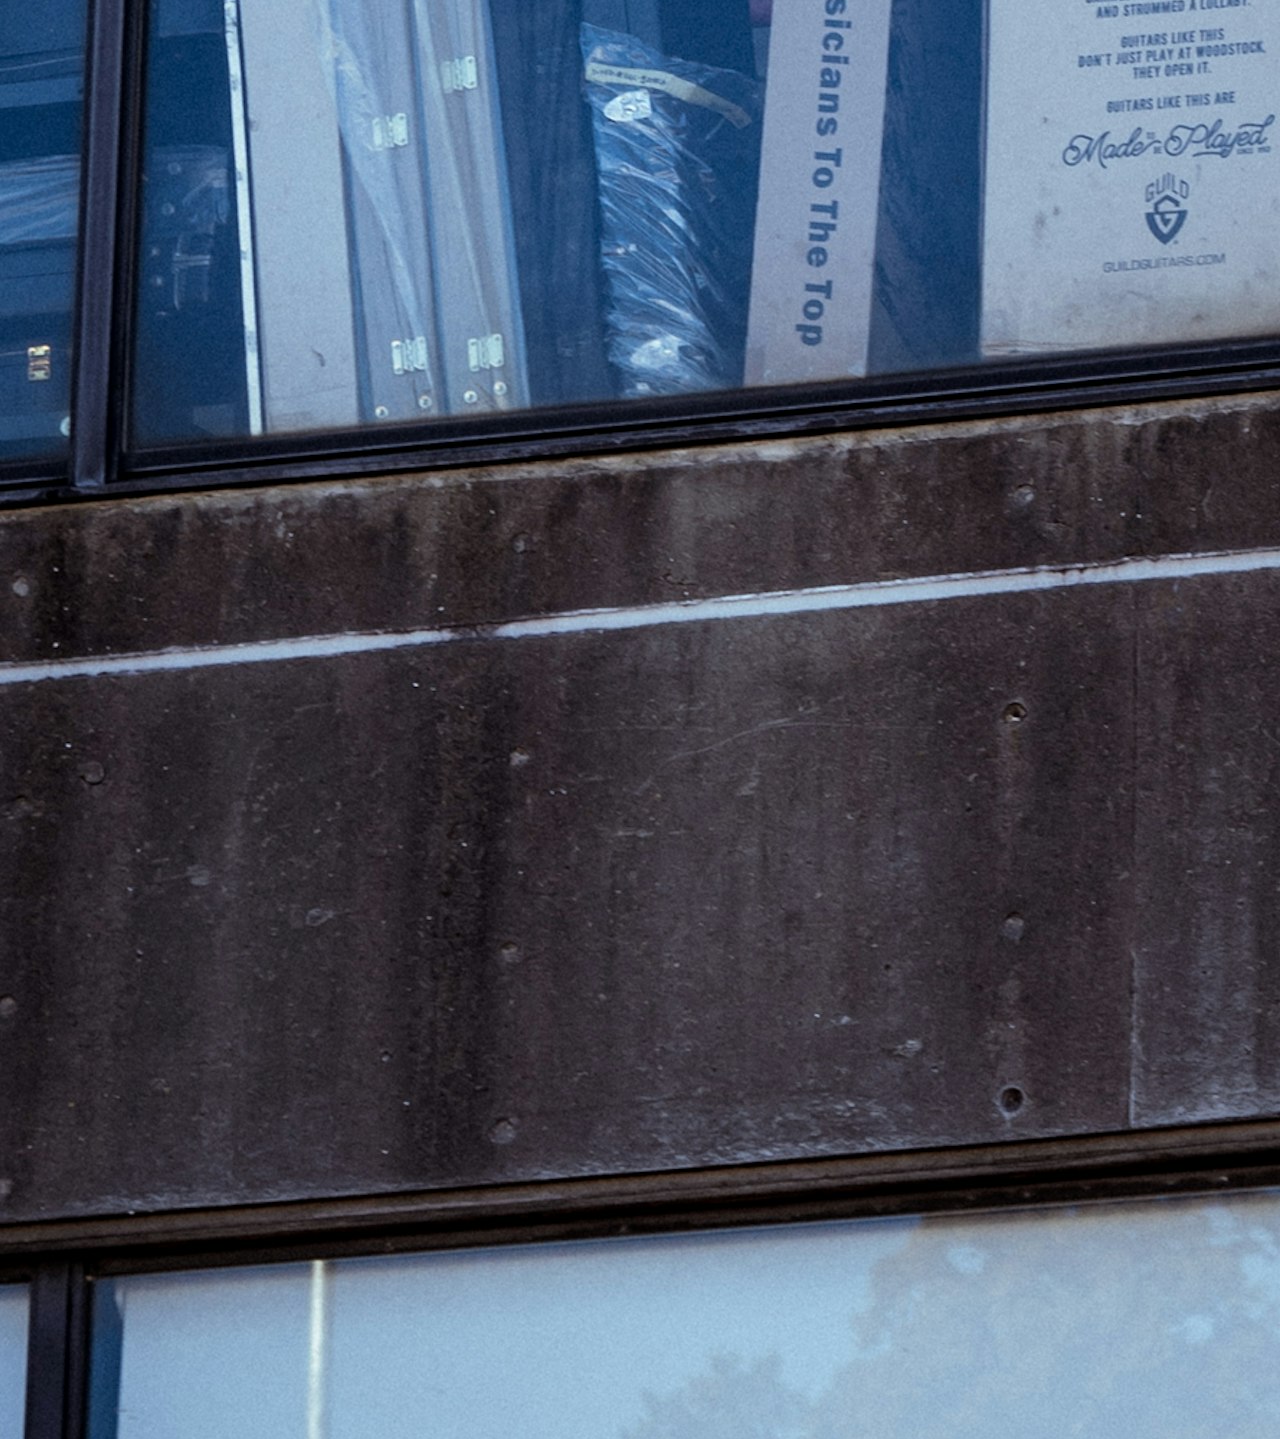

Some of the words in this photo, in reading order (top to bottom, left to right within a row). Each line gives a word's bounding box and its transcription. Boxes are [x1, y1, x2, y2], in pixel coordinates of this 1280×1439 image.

[1096, 5, 1119, 18] AND
[1123, 0, 1185, 17] STRUMMED
[1189, 0, 1197, 11] A
[1120, 32, 1168, 48] GUITARS
[1171, 30, 1196, 45] LIKE
[1199, 28, 1225, 42] THIS
[1078, 53, 1112, 68] DON'T
[1115, 50, 1143, 65] JUST
[1146, 49, 1174, 62] PLAY
[1178, 46, 1191, 59] AT
[1133, 65, 1161, 79] THEY
[1164, 63, 1194, 77] OPEN
[1106, 98, 1154, 113] GUITARS
[1157, 95, 1181, 109] LIKE
[1185, 93, 1211, 107] THIS
[1214, 91, 1235, 104] ARE
[1062, 127, 1161, 169] Made
[1164, 114, 1276, 158] Played
[812, 148, 842, 188] To
[1145, 172, 1190, 202] GUILD
[806, 200, 838, 268] The
[1103, 254, 1226, 273] GUILDGUITARS.COM
[796, 280, 833, 346] Top
